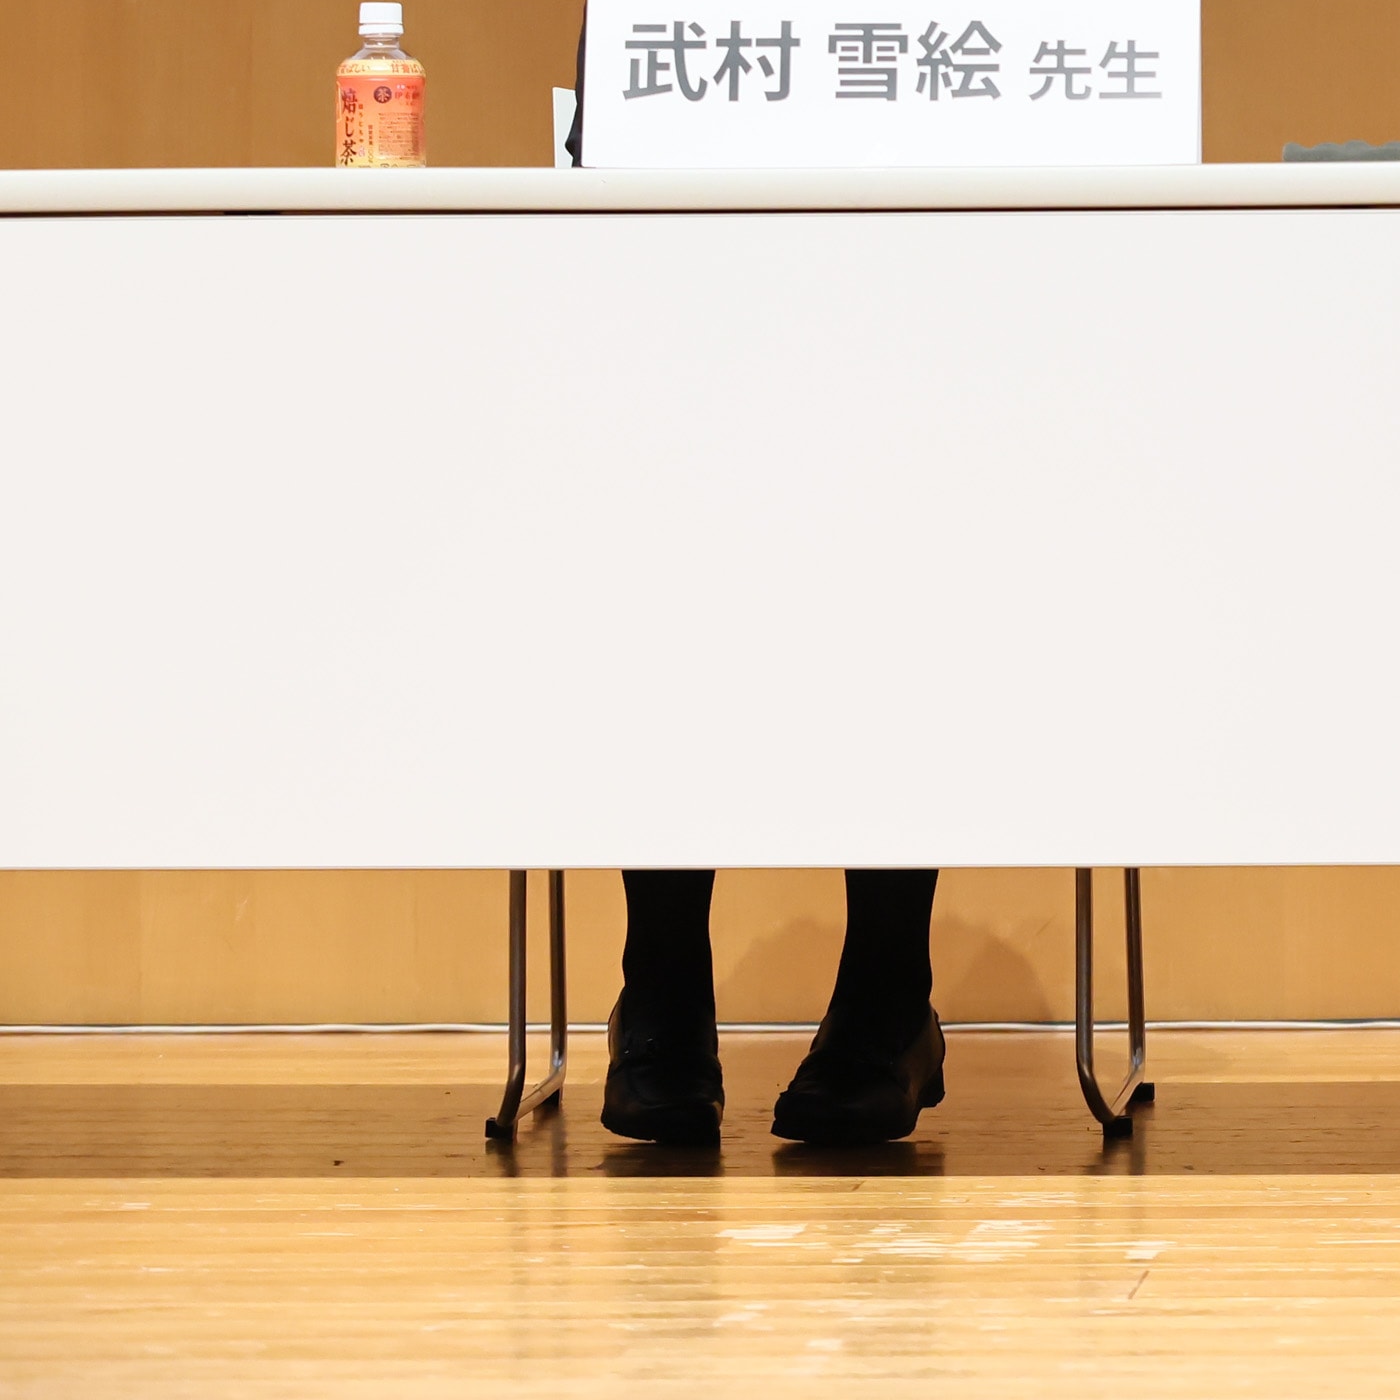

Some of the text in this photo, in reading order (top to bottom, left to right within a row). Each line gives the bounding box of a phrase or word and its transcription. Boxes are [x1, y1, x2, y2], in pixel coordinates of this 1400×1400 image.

[622, 19, 1162, 102] 武村 雪絵 先生
